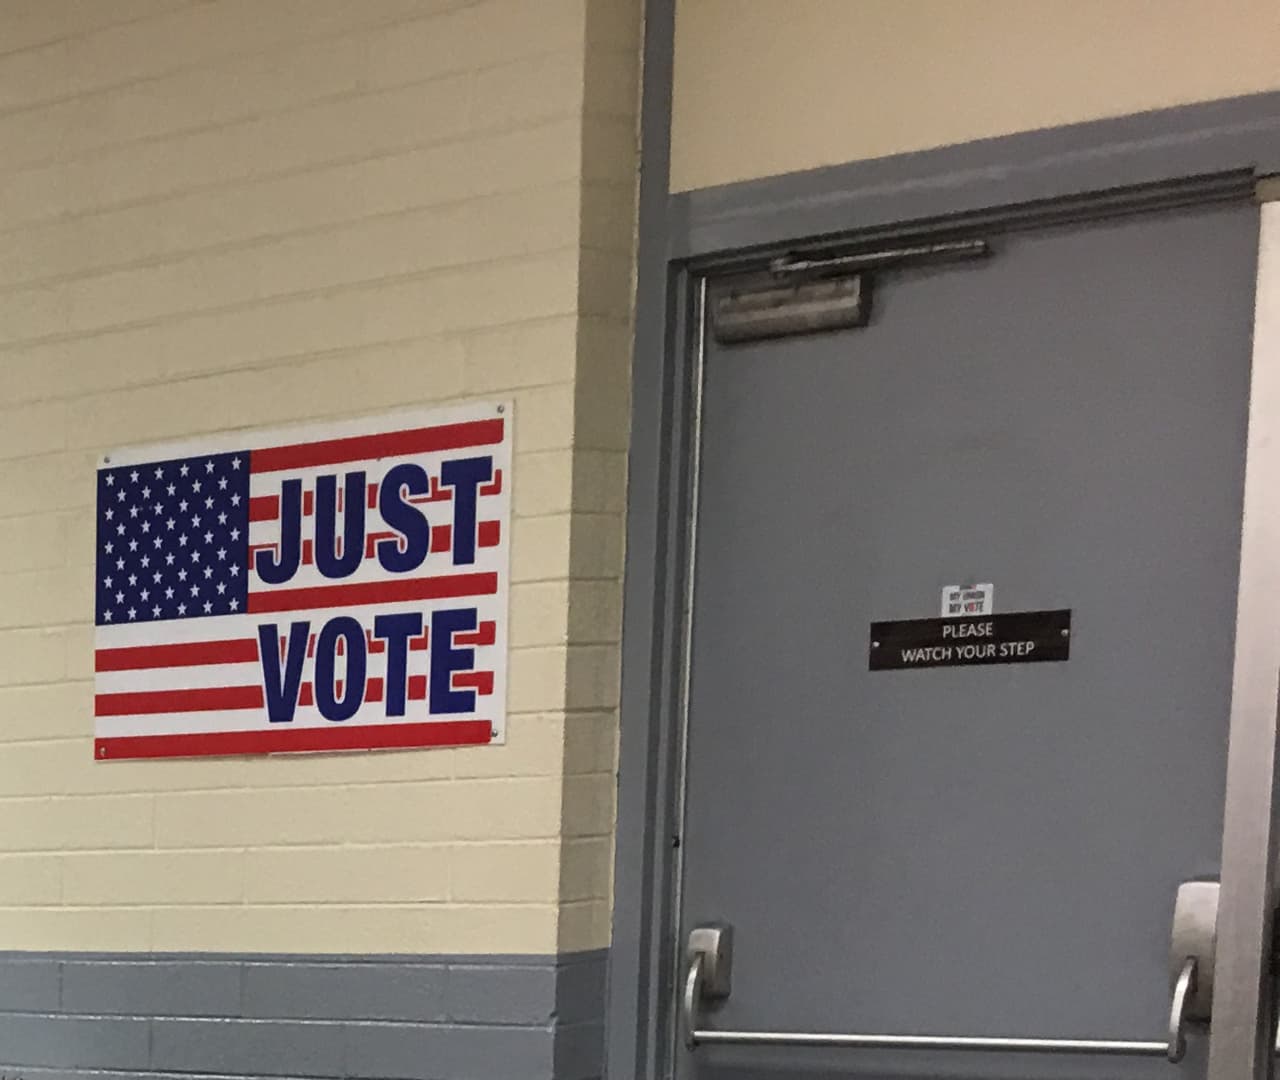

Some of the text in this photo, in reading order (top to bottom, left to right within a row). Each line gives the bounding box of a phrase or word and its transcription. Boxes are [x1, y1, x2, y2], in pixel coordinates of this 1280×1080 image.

[256, 456, 493, 584] JUST
[901, 641, 1035, 662] WATCH YOUR STEP
[942, 622, 993, 638] PLEASE
[258, 607, 478, 723] VOTE
